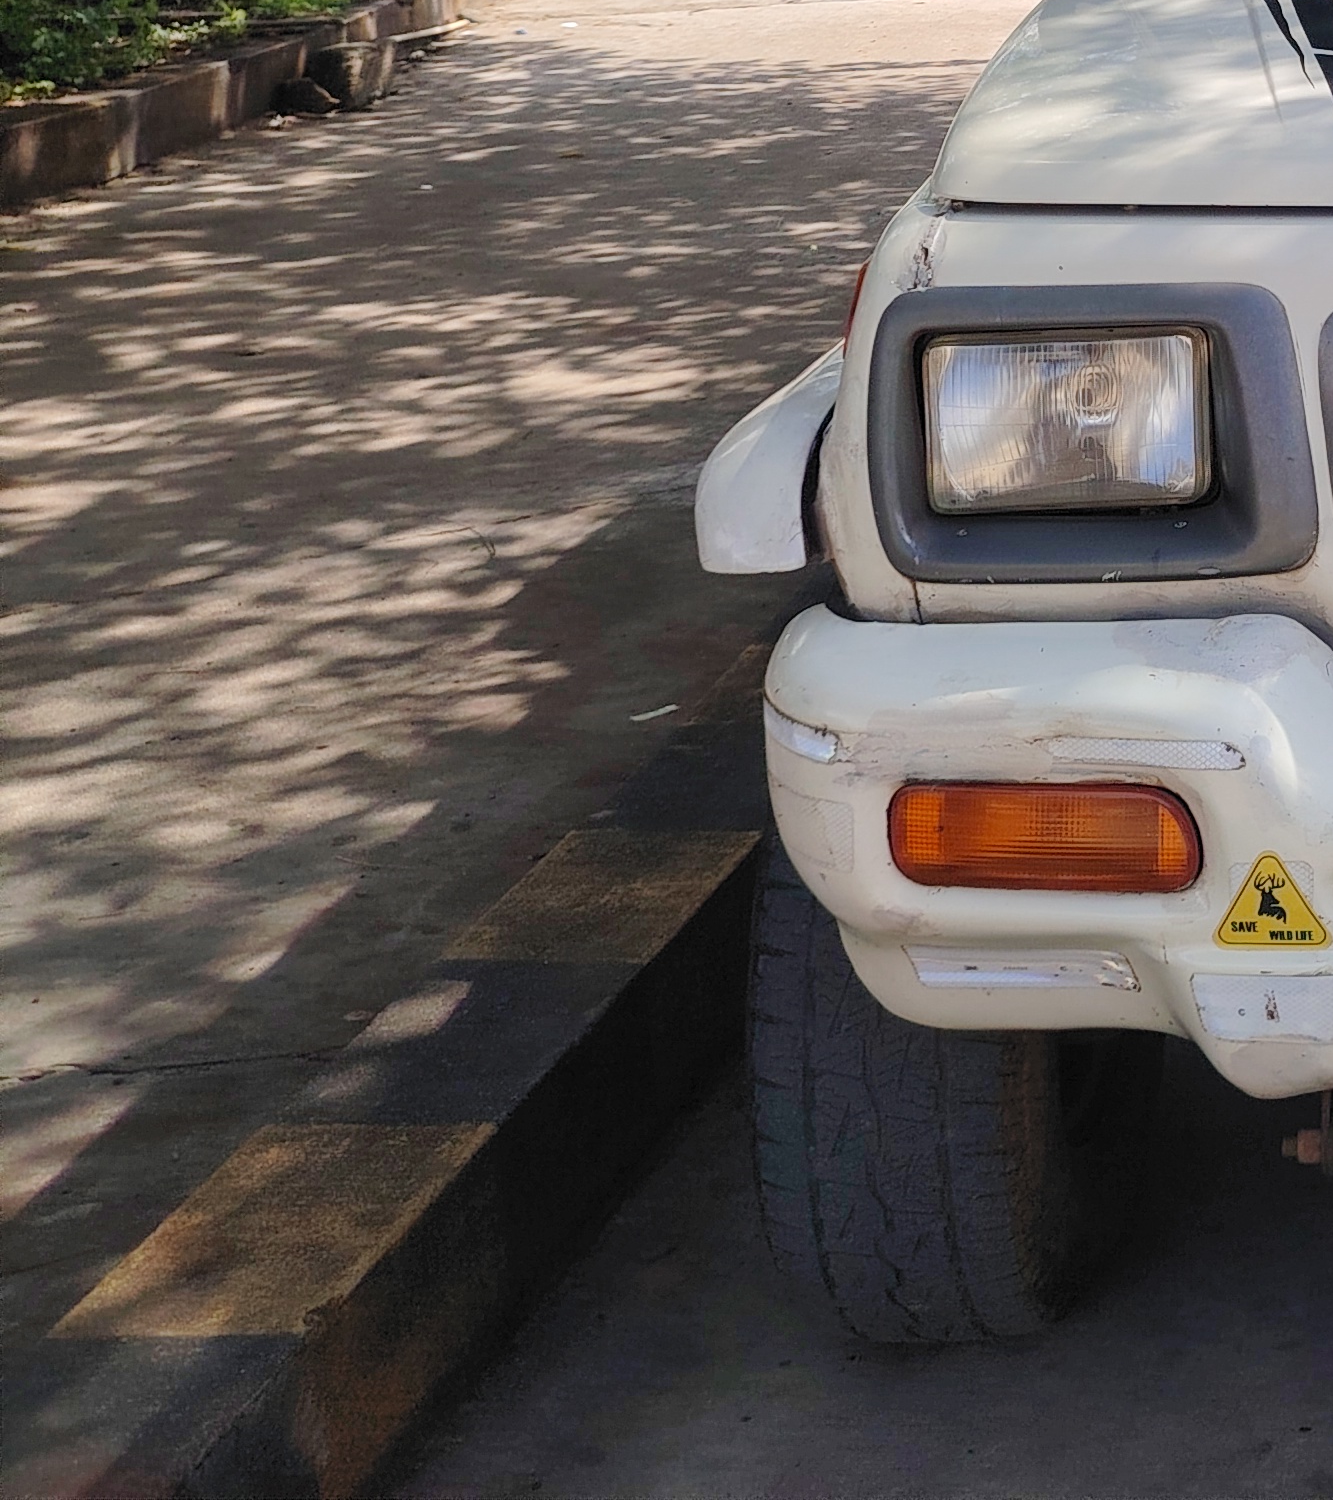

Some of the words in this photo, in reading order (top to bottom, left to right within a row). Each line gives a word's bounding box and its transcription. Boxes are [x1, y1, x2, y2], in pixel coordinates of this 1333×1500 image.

[1231, 921, 1259, 933] SAVE
[1269, 930, 1293, 941] WILD
[1295, 930, 1315, 941] LIFE
[1238, 1008, 1246, 1017] C
